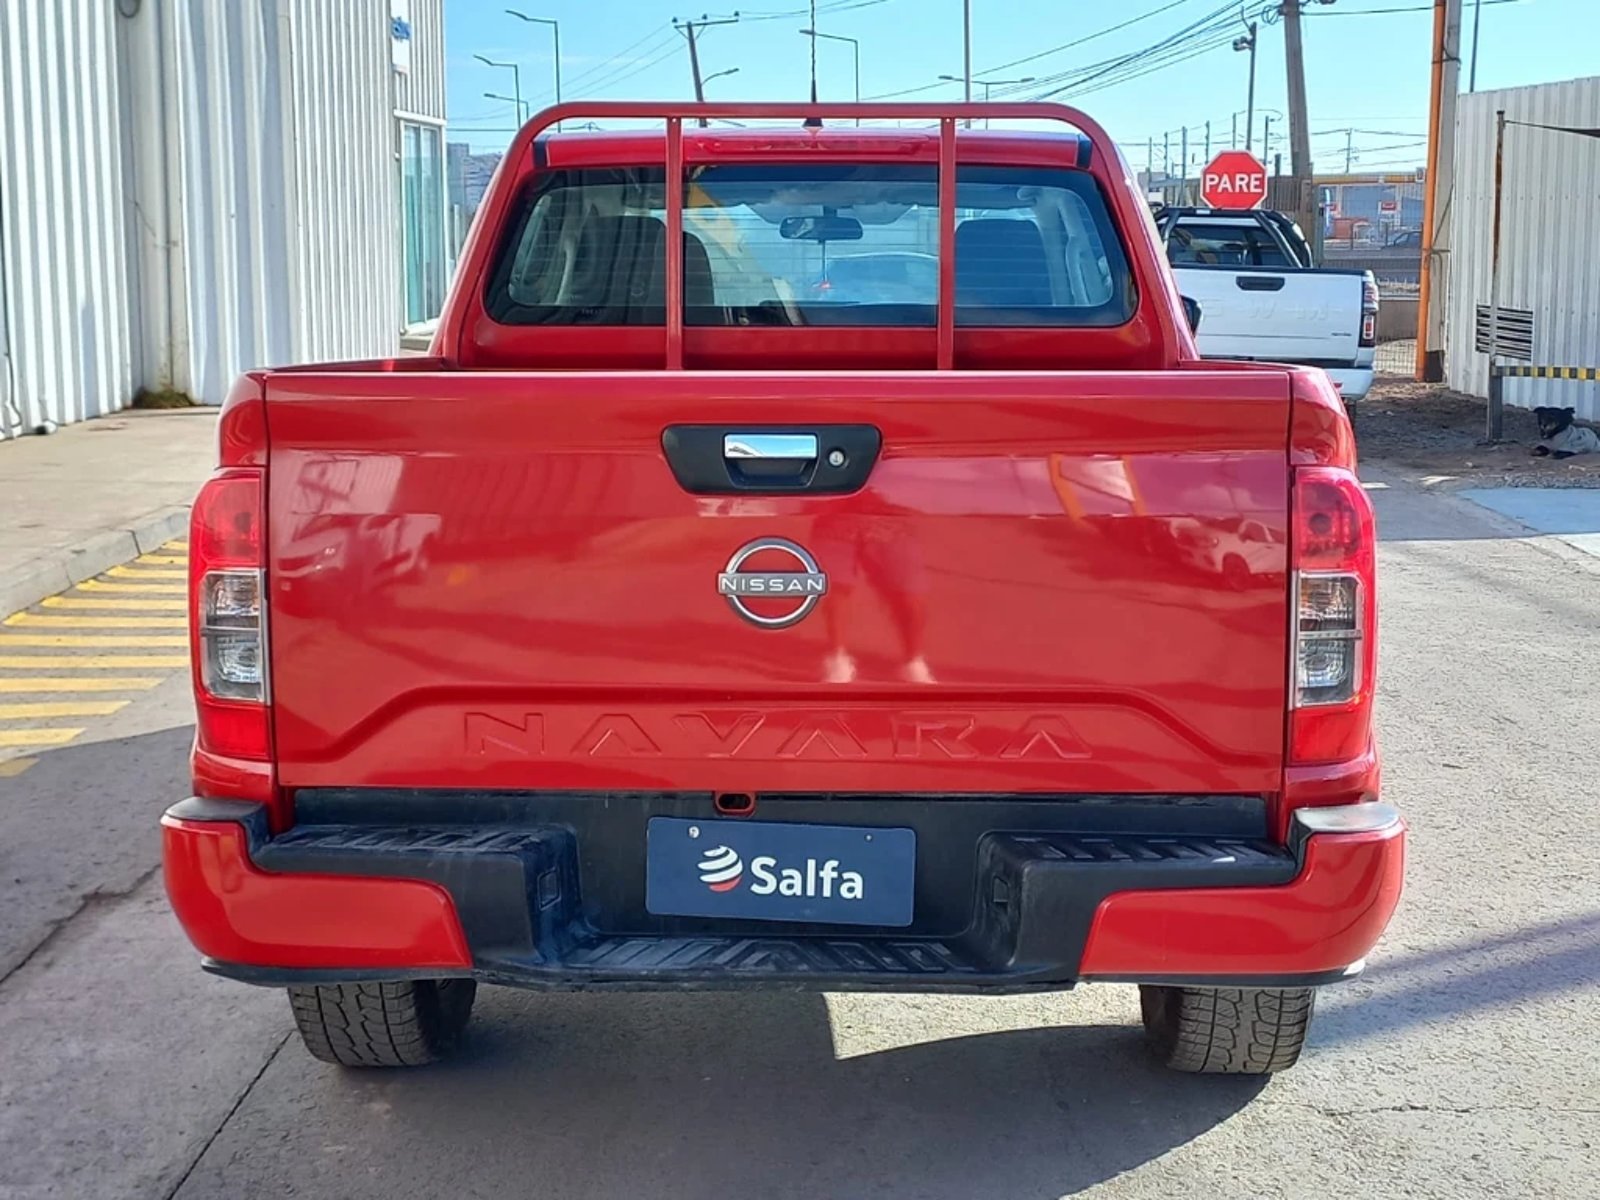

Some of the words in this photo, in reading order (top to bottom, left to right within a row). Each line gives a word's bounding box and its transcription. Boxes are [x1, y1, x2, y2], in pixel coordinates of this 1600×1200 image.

[1205, 173, 1263, 193] PARE
[721, 578, 823, 592] NISSAN
[465, 711, 1092, 758] NAVARA
[750, 856, 864, 900] Salfa
